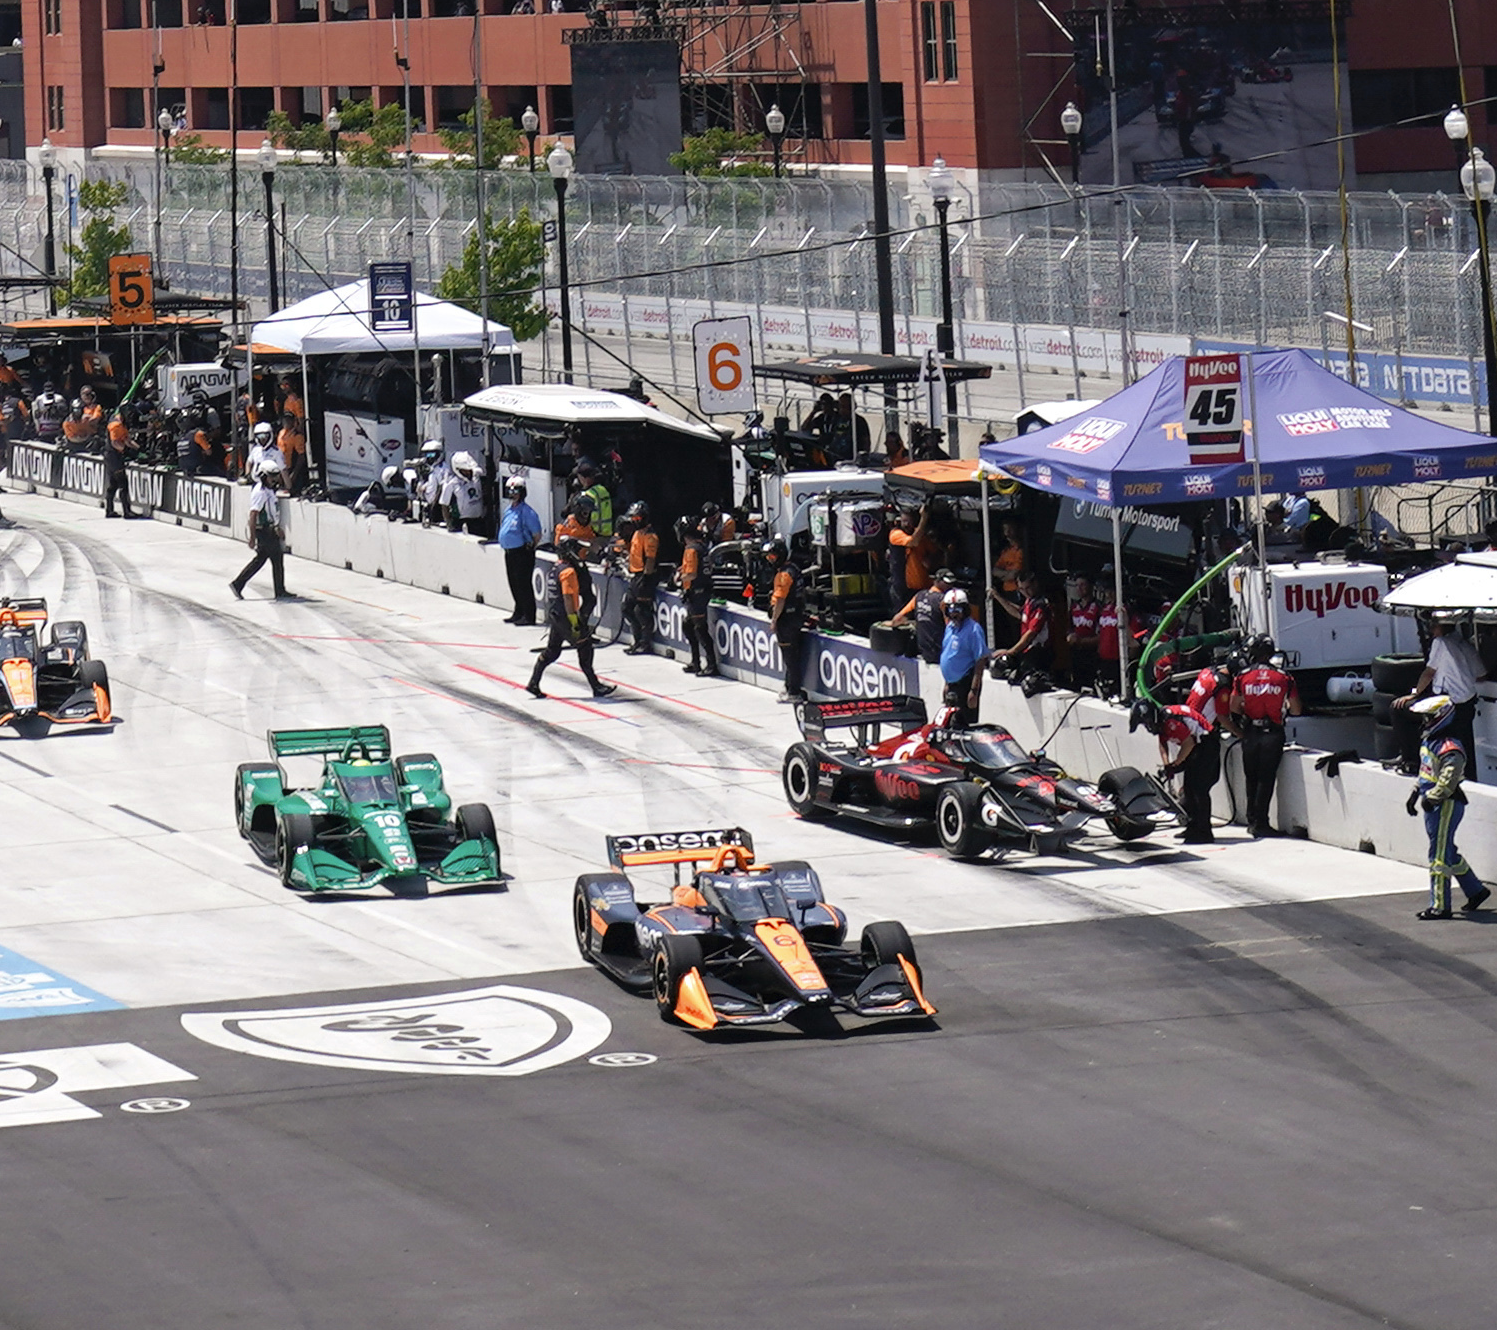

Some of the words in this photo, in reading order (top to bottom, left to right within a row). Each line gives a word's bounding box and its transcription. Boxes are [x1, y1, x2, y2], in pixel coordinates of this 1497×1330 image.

[119, 271, 145, 308] 5
[383, 300, 401, 321] 10
[708, 342, 742, 391] 6
[1189, 361, 1237, 380] HyVee
[1384, 364, 1421, 392] NTT
[1190, 388, 1237, 426] 45
[1079, 418, 1123, 437] LIQUI
[1282, 410, 1328, 426] LIQUI
[1288, 421, 1338, 436] MOLY
[1055, 434, 1105, 453] MOLY
[1414, 456, 1440, 466] LIQUI
[1184, 475, 1212, 485] LIQUI
[1297, 467, 1325, 477] LIQUI
[1414, 466, 1441, 476] MOLY
[1186, 485, 1214, 495] MOLY
[1298, 476, 1326, 486] MOLY
[1088, 500, 1123, 520] Turner
[1122, 505, 1181, 532] Motorsport
[1285, 582, 1380, 618] HyVee
[715, 619, 784, 672] onse
[819, 650, 907, 697] onsemi
[374, 815, 401, 828] 10
